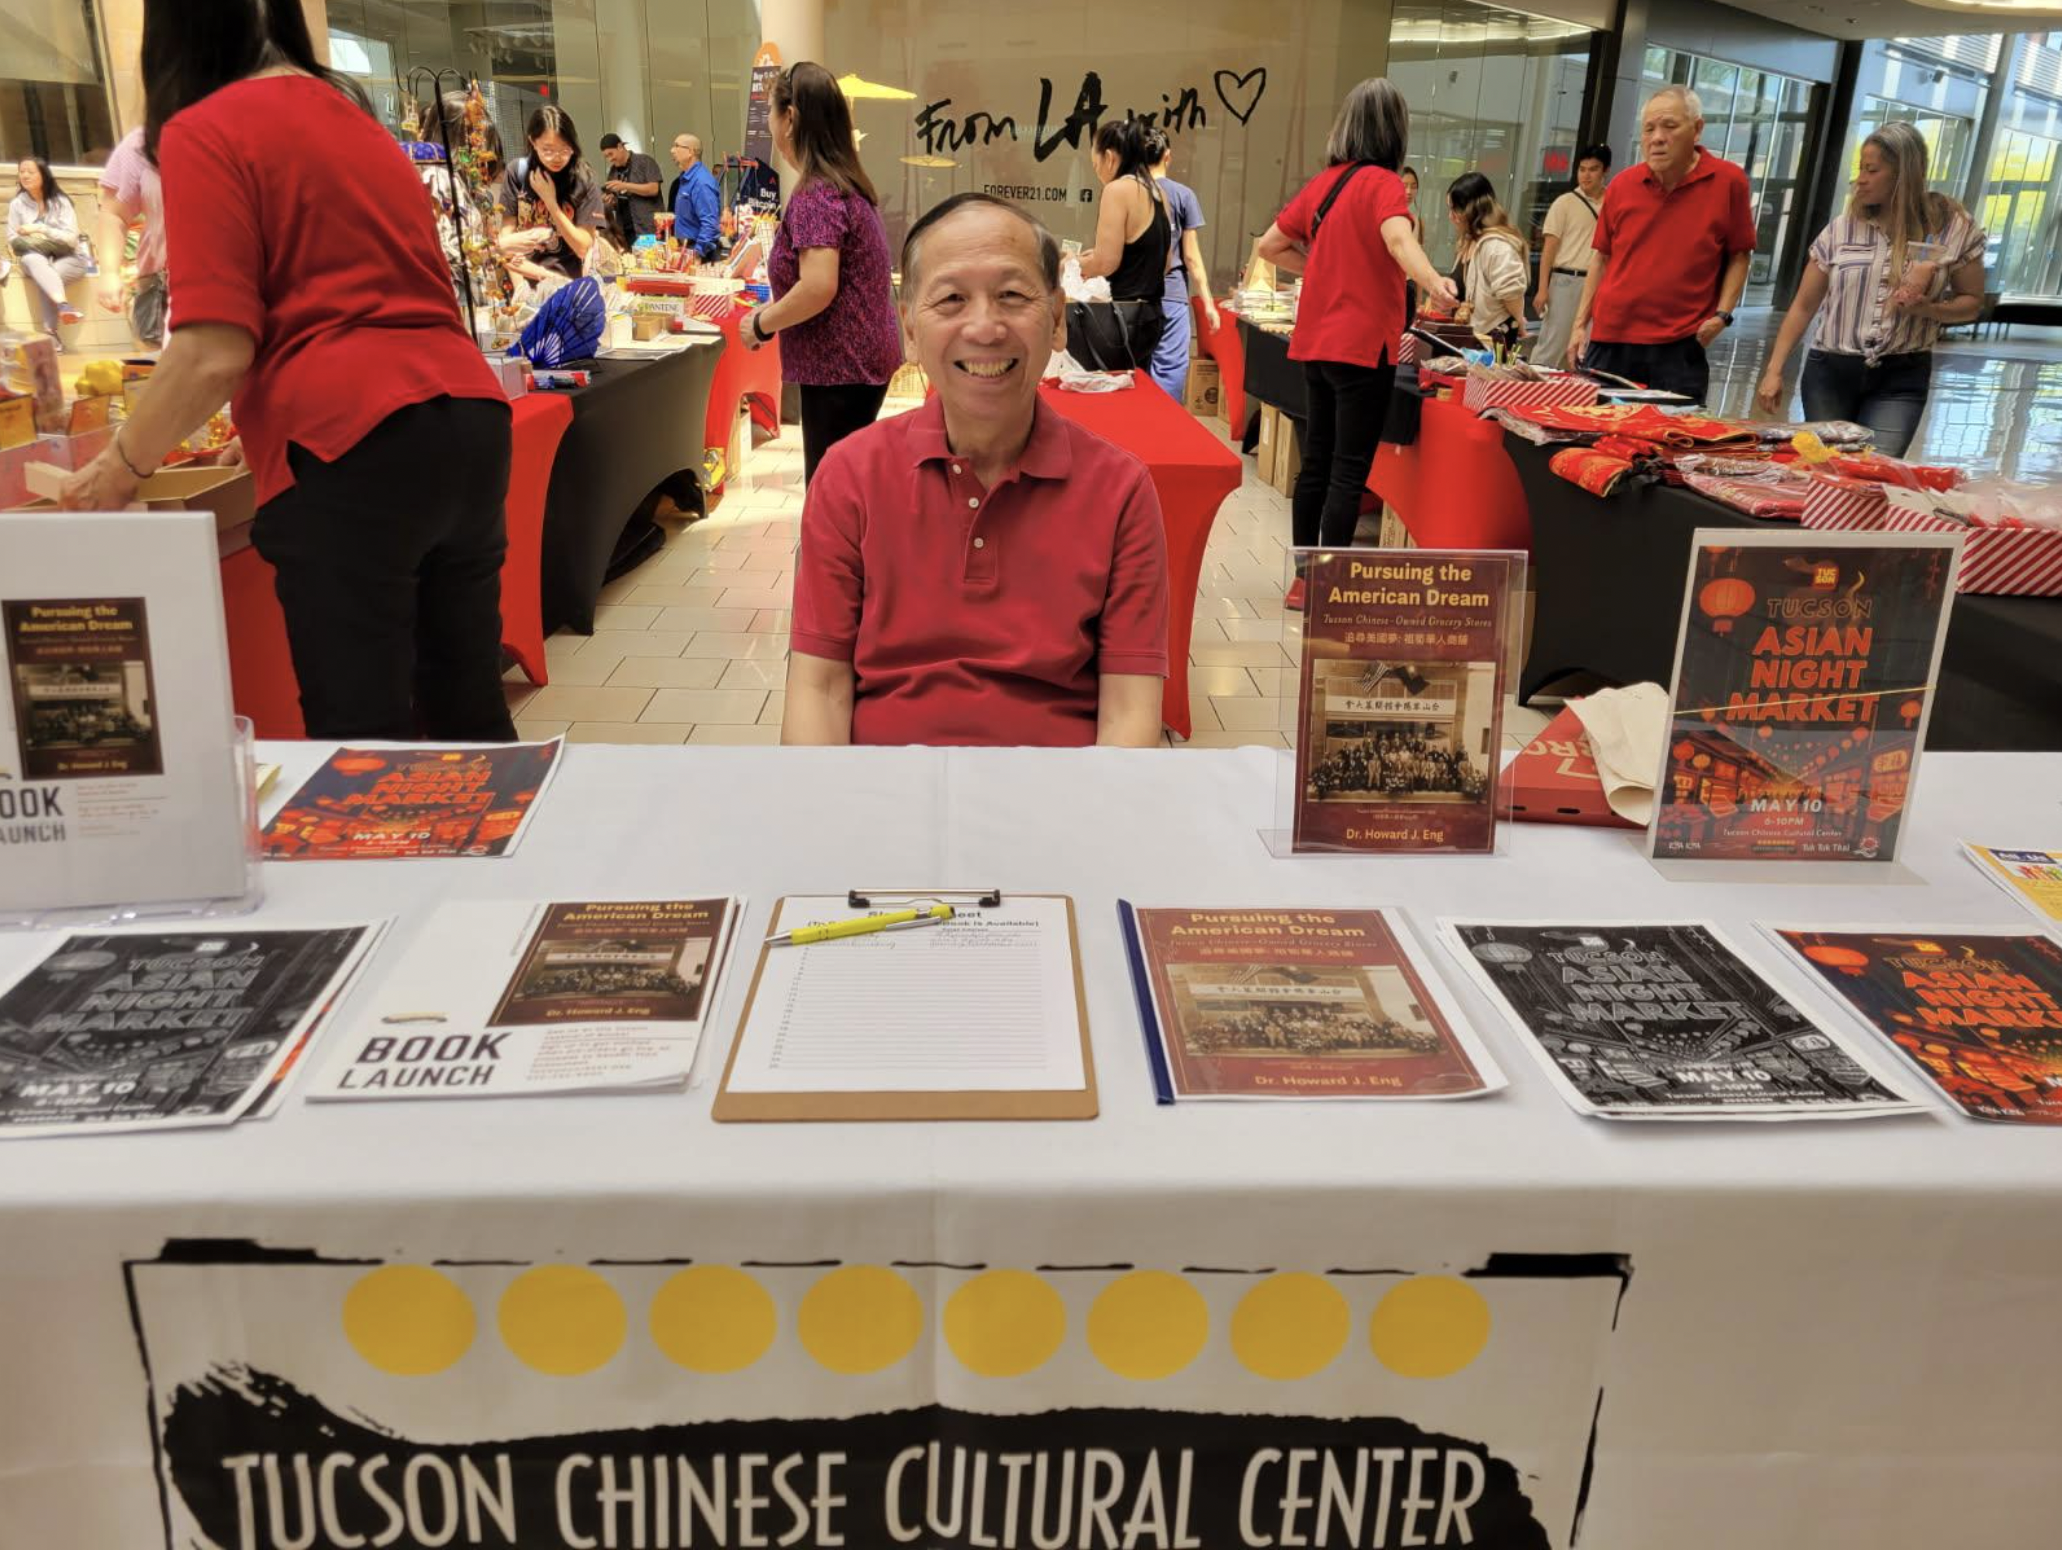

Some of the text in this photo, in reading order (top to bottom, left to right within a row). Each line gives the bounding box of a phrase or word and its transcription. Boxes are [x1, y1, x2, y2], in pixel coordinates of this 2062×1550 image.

[915, 98, 1017, 155] From
[1033, 71, 1108, 162] LA
[760, 187, 777, 200] Buy
[983, 184, 1067, 202] FOREVER21.COM
[1350, 562, 1472, 584] Pursuing the
[1328, 586, 1489, 607] American Dream
[31, 605, 118, 619] Pursuing the
[1767, 598, 1873, 619] TUCSON
[19, 620, 133, 632] American Dream
[1752, 625, 1873, 656] ASIAN
[1750, 659, 1868, 689] NIGHT
[1726, 692, 1880, 722] MARKET
[0, 786, 64, 819] OOK
[1750, 799, 1822, 813] MAY 10
[0, 824, 66, 845] AUNCH
[1346, 829, 1444, 842] Dr. Howard J. Eng
[563, 911, 710, 921] American Dream
[585, 902, 694, 913] Pursuing the
[1190, 913, 1336, 925] Pursuing the
[1171, 925, 1366, 937] American Dream
[93, 969, 261, 993] ASIAN
[1562, 965, 1694, 984] ASIAN
[1902, 970, 2042, 992] ASIAN
[77, 989, 245, 1012] NIGHT
[1571, 983, 1706, 1001] NIGHT
[1915, 988, 2060, 1010] NIGHT
[30, 1006, 254, 1032] MARKET
[1568, 1001, 1748, 1021] MARKET
[1915, 1006, 2062, 1029] MARK
[355, 1032, 513, 1064] BOOK
[337, 1064, 496, 1090] LAUNCH
[1255, 1075, 1403, 1087] Dr. Howard J. Eng
[1674, 1070, 1773, 1084] MAY 10
[19, 1081, 137, 1097] MAY 10
[221, 1440, 1487, 1550] TUCSON CHINESE CULTURAL CENTER
